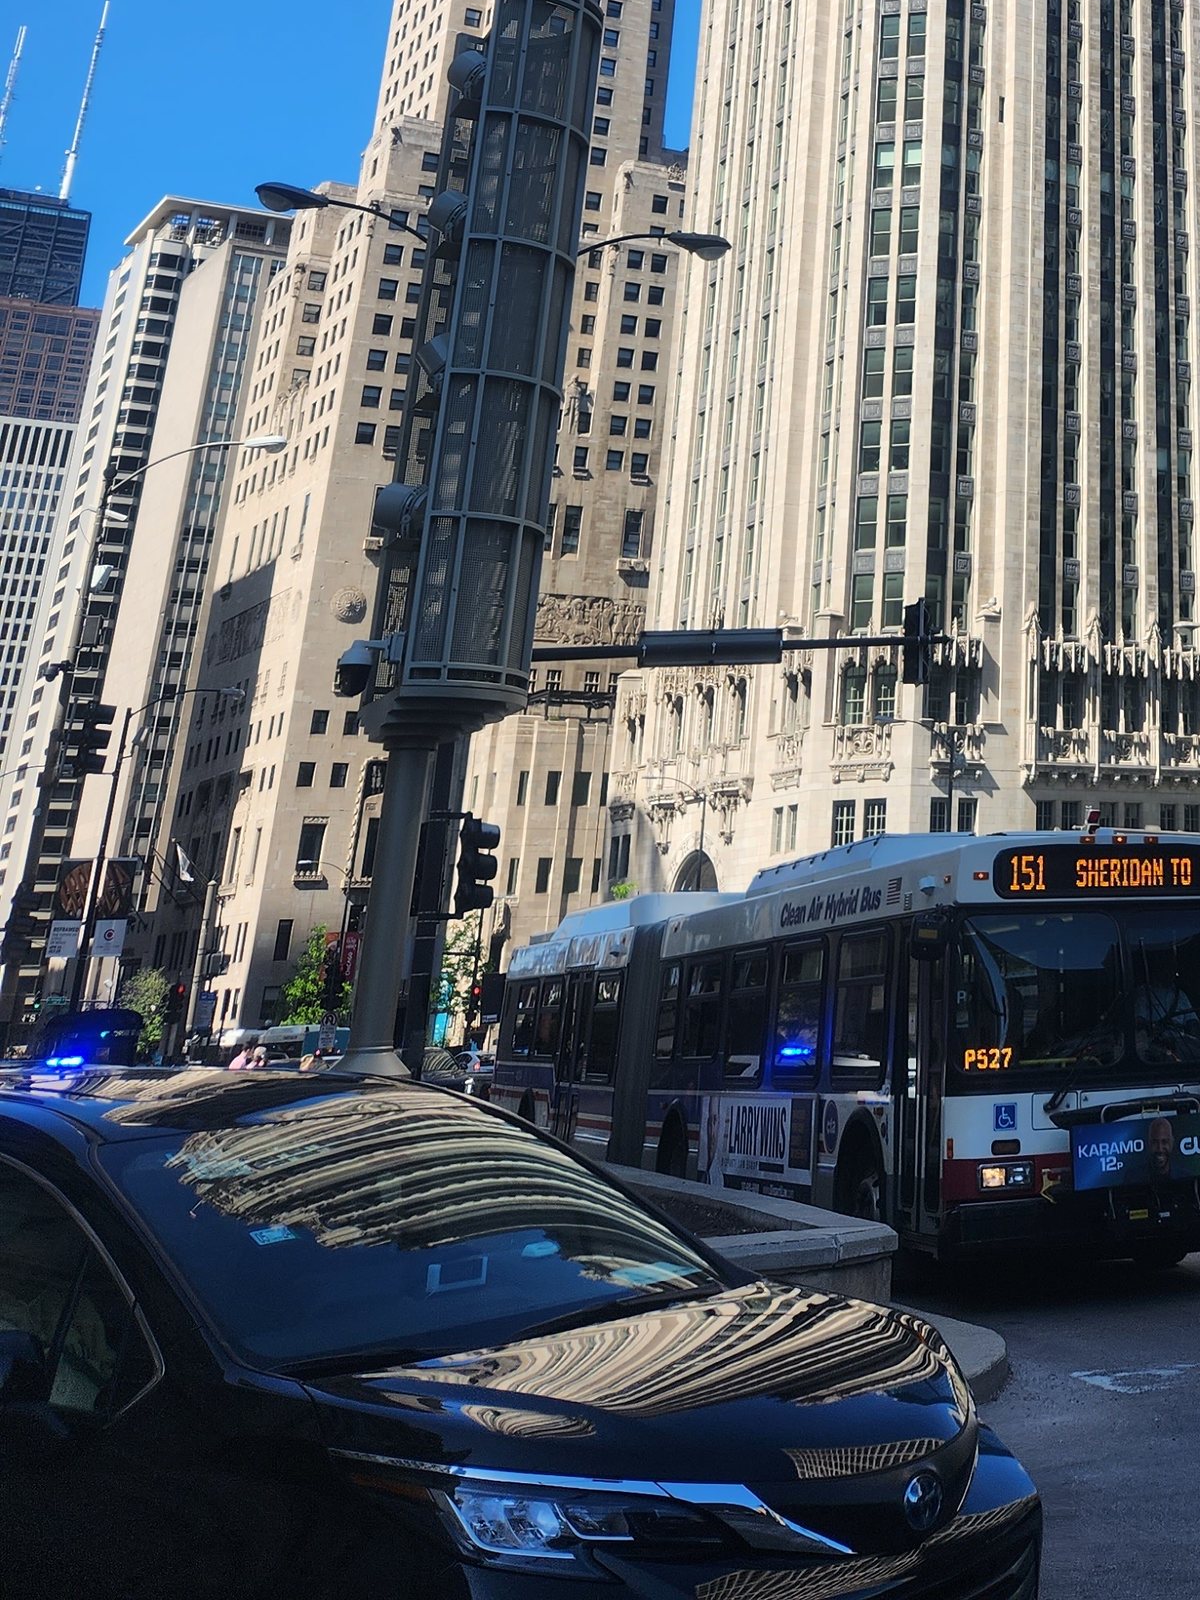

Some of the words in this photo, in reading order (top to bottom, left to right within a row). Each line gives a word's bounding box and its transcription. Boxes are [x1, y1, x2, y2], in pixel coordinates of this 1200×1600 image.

[1009, 855, 1046, 891] 151
[1076, 858, 1164, 887] SHERIDAN
[1170, 857, 1192, 885] TO
[780, 902, 806, 928] Clean
[807, 894, 824, 922] Air
[824, 887, 860, 924] Hybrid
[860, 886, 881, 913] Bus
[964, 1047, 1013, 1070] P527
[729, 1105, 760, 1156] LARRY
[760, 1106, 787, 1160] WINS
[1078, 1139, 1144, 1158] KARAMO
